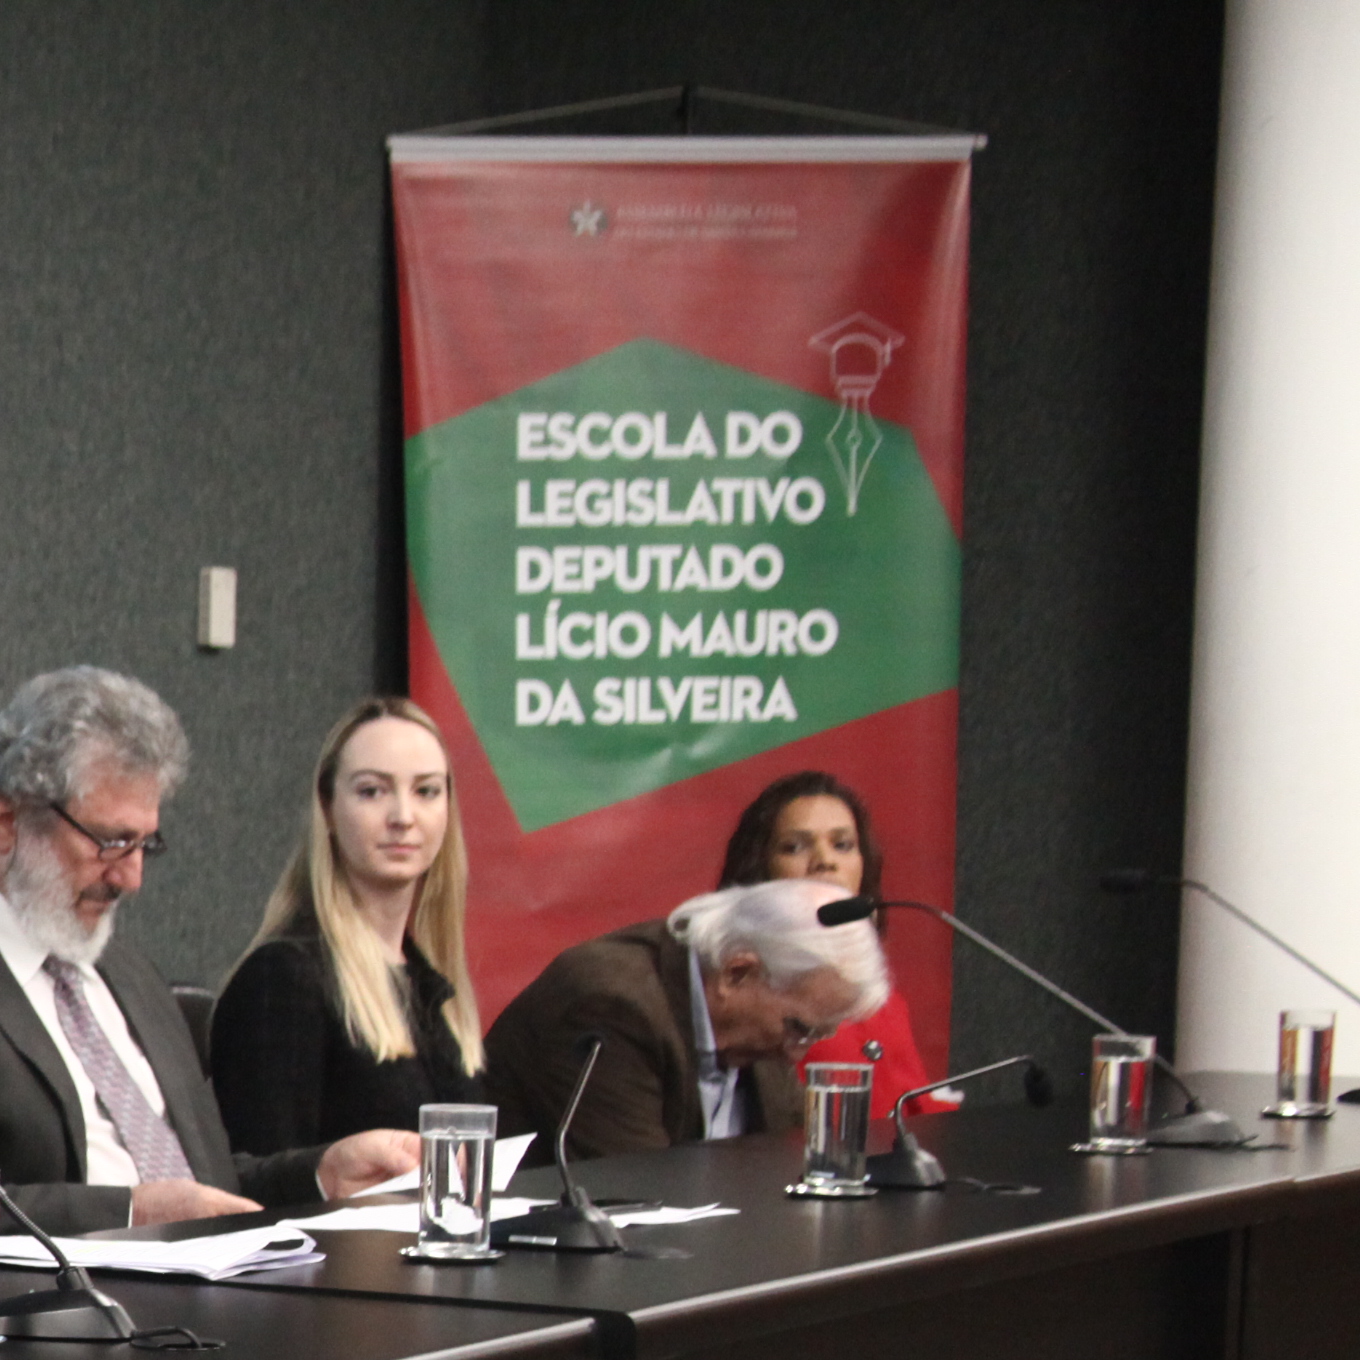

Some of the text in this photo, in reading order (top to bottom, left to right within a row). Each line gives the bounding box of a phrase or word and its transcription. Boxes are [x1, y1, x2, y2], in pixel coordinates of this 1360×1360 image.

[516, 410, 803, 462] ESCOLA DO
[515, 476, 826, 528] LEGISLATIVO
[515, 543, 784, 595] DEPUTADO
[515, 599, 839, 660] LÍCIO MAURO
[515, 675, 798, 726] DA SILVEIRA
